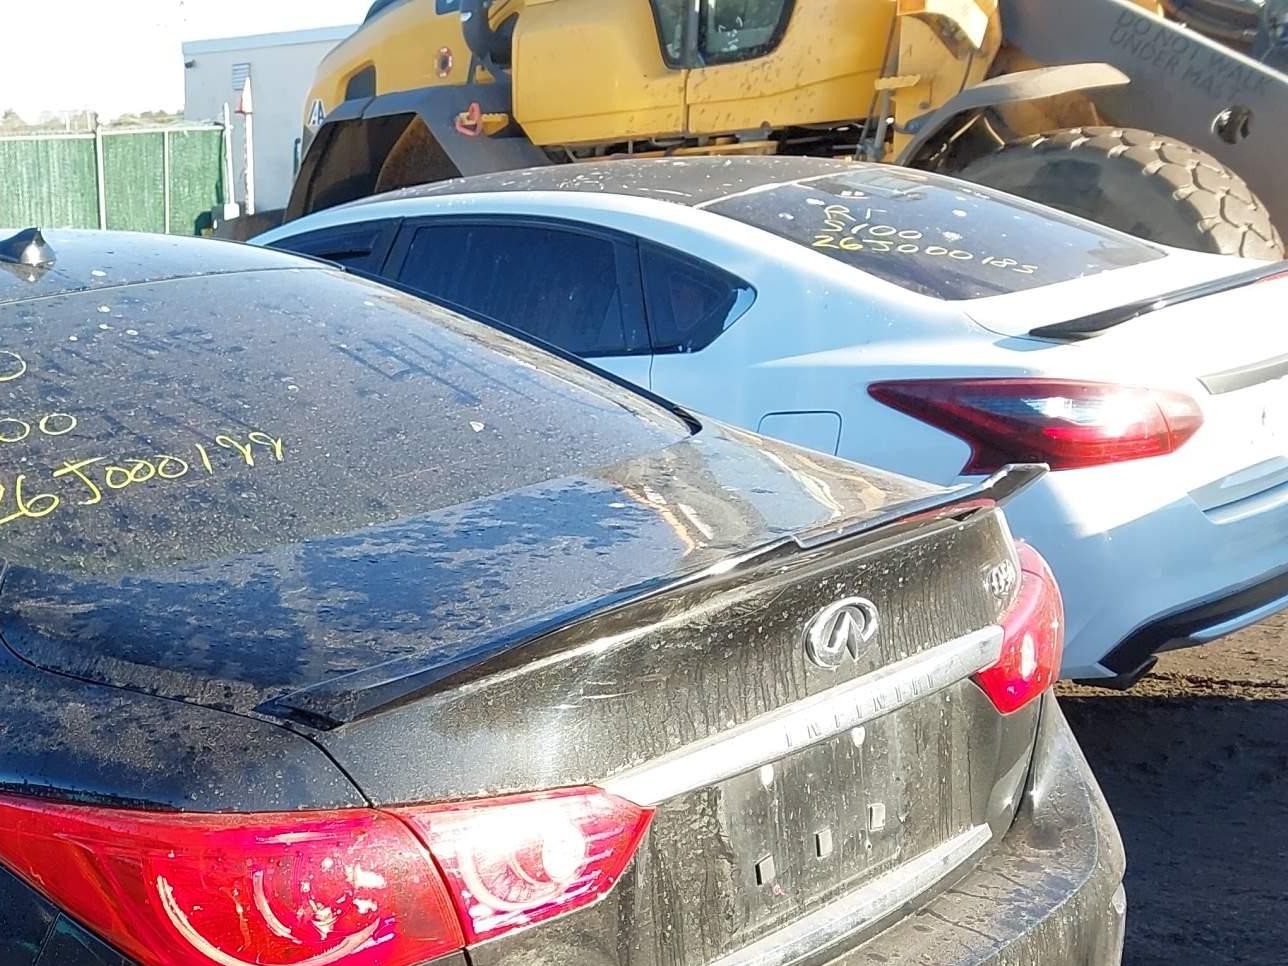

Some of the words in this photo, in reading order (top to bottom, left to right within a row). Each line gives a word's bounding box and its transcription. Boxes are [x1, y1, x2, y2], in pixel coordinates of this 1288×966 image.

[1109, 25, 1180, 73] UNDER
[1117, 9, 1152, 35] DO
[1154, 28, 1201, 61] NOT
